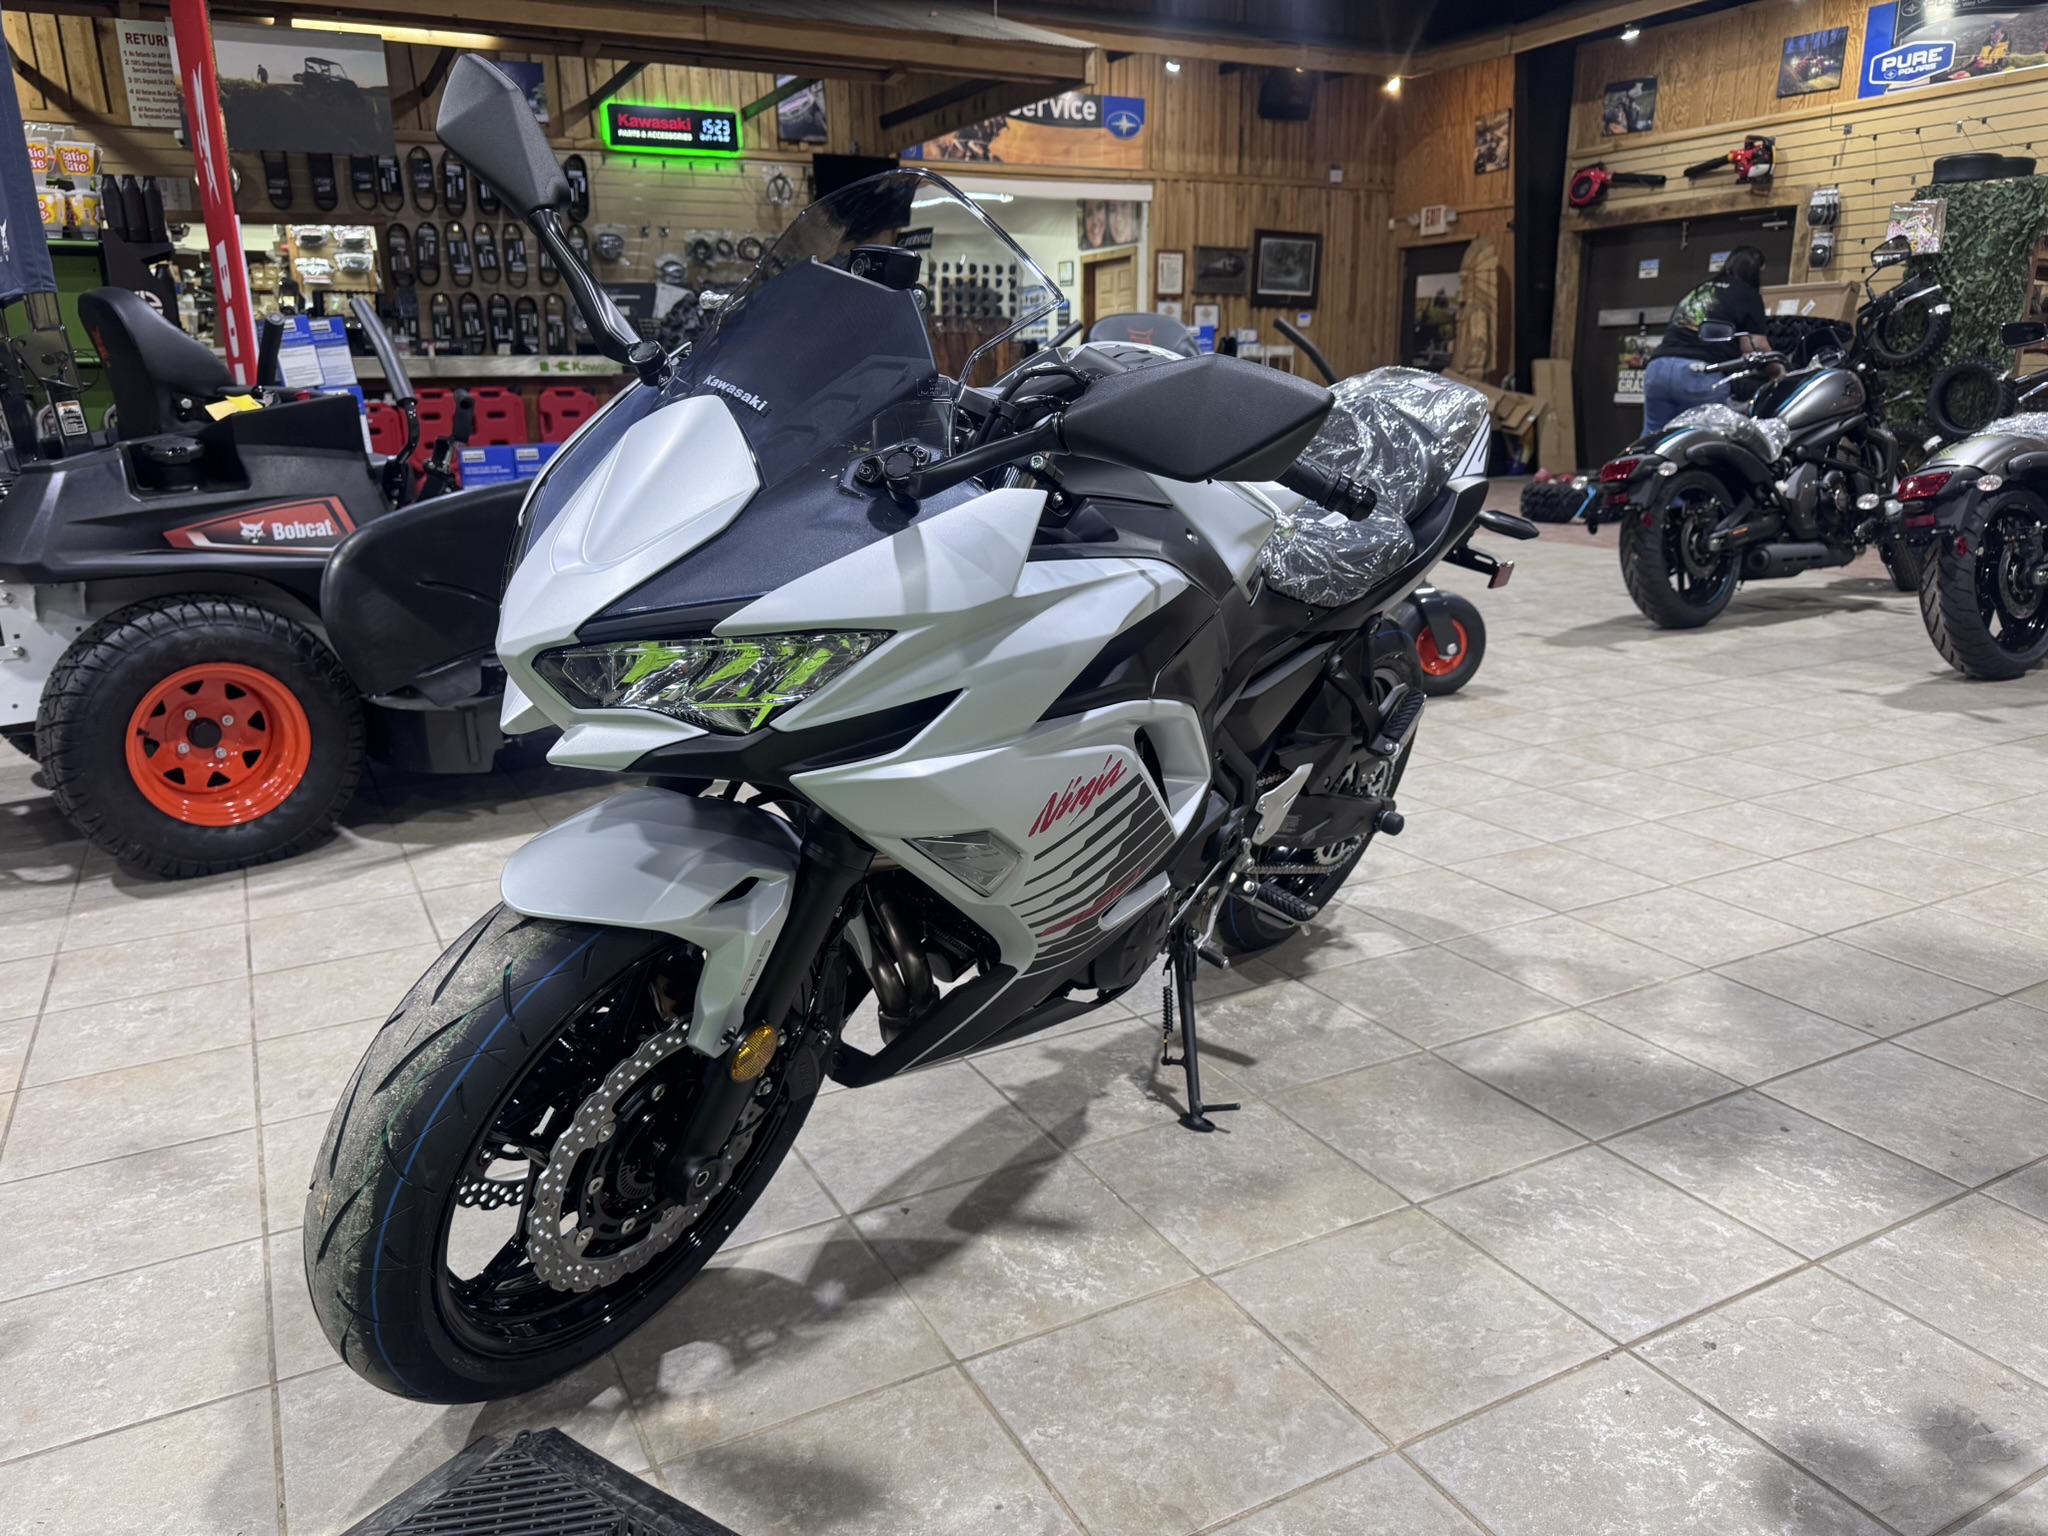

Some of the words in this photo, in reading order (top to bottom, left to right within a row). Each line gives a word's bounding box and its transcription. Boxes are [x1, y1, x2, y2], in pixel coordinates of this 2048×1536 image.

[1881, 47, 1943, 72] PURE
[1898, 63, 1937, 76] POLARIS
[617, 113, 692, 131] Kawasaki
[702, 374, 768, 411] Kawasaki
[271, 519, 334, 541] Bobcat
[1028, 754, 1127, 837] Ninja
[740, 939, 771, 996] ABS
